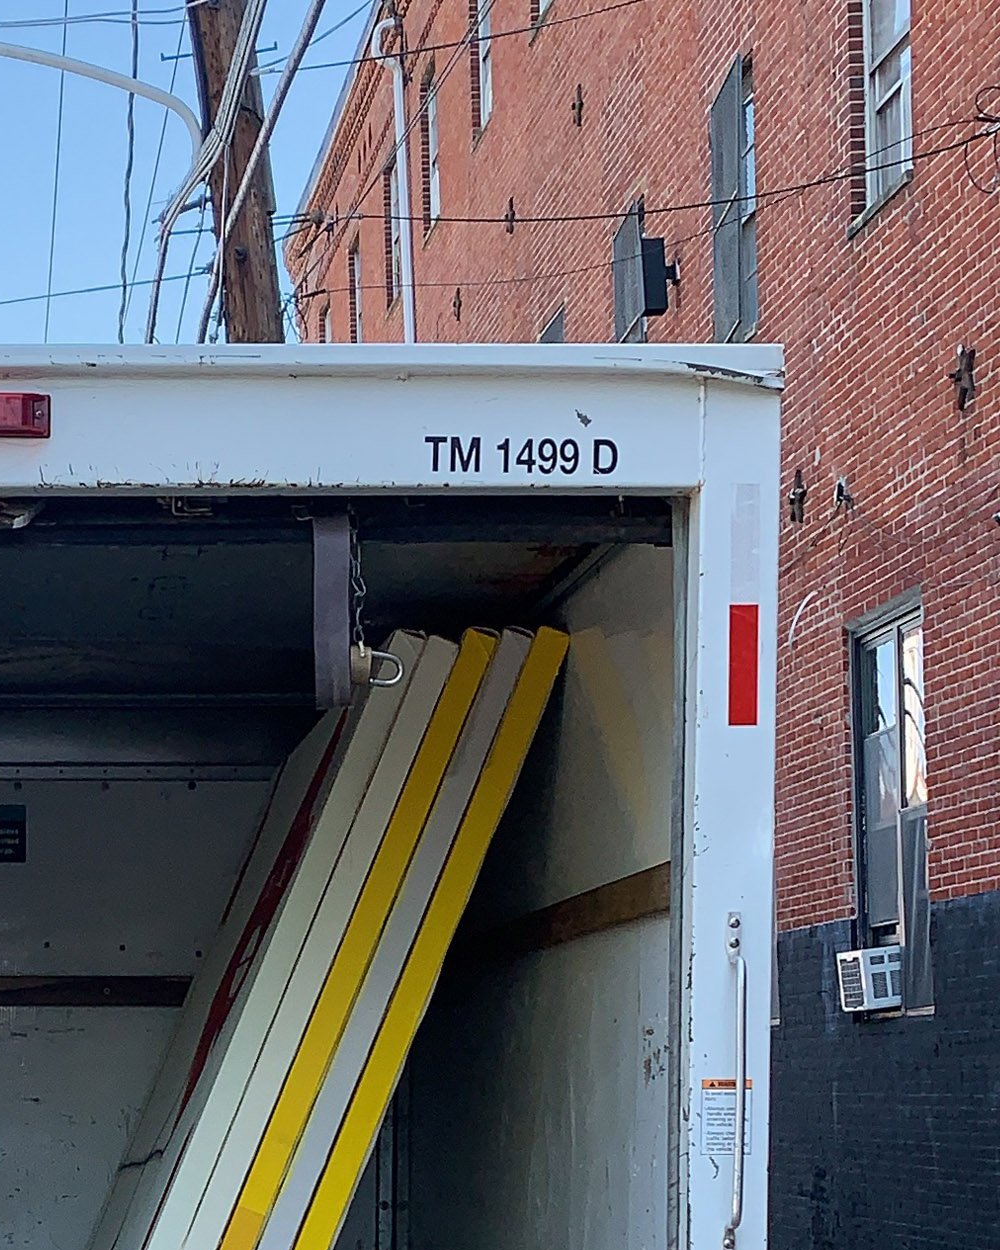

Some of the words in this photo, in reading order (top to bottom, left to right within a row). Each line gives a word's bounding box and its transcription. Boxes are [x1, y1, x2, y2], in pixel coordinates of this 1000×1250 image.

[424, 436, 482, 473] TM
[496, 437, 580, 475] 1499
[592, 439, 619, 475] D
